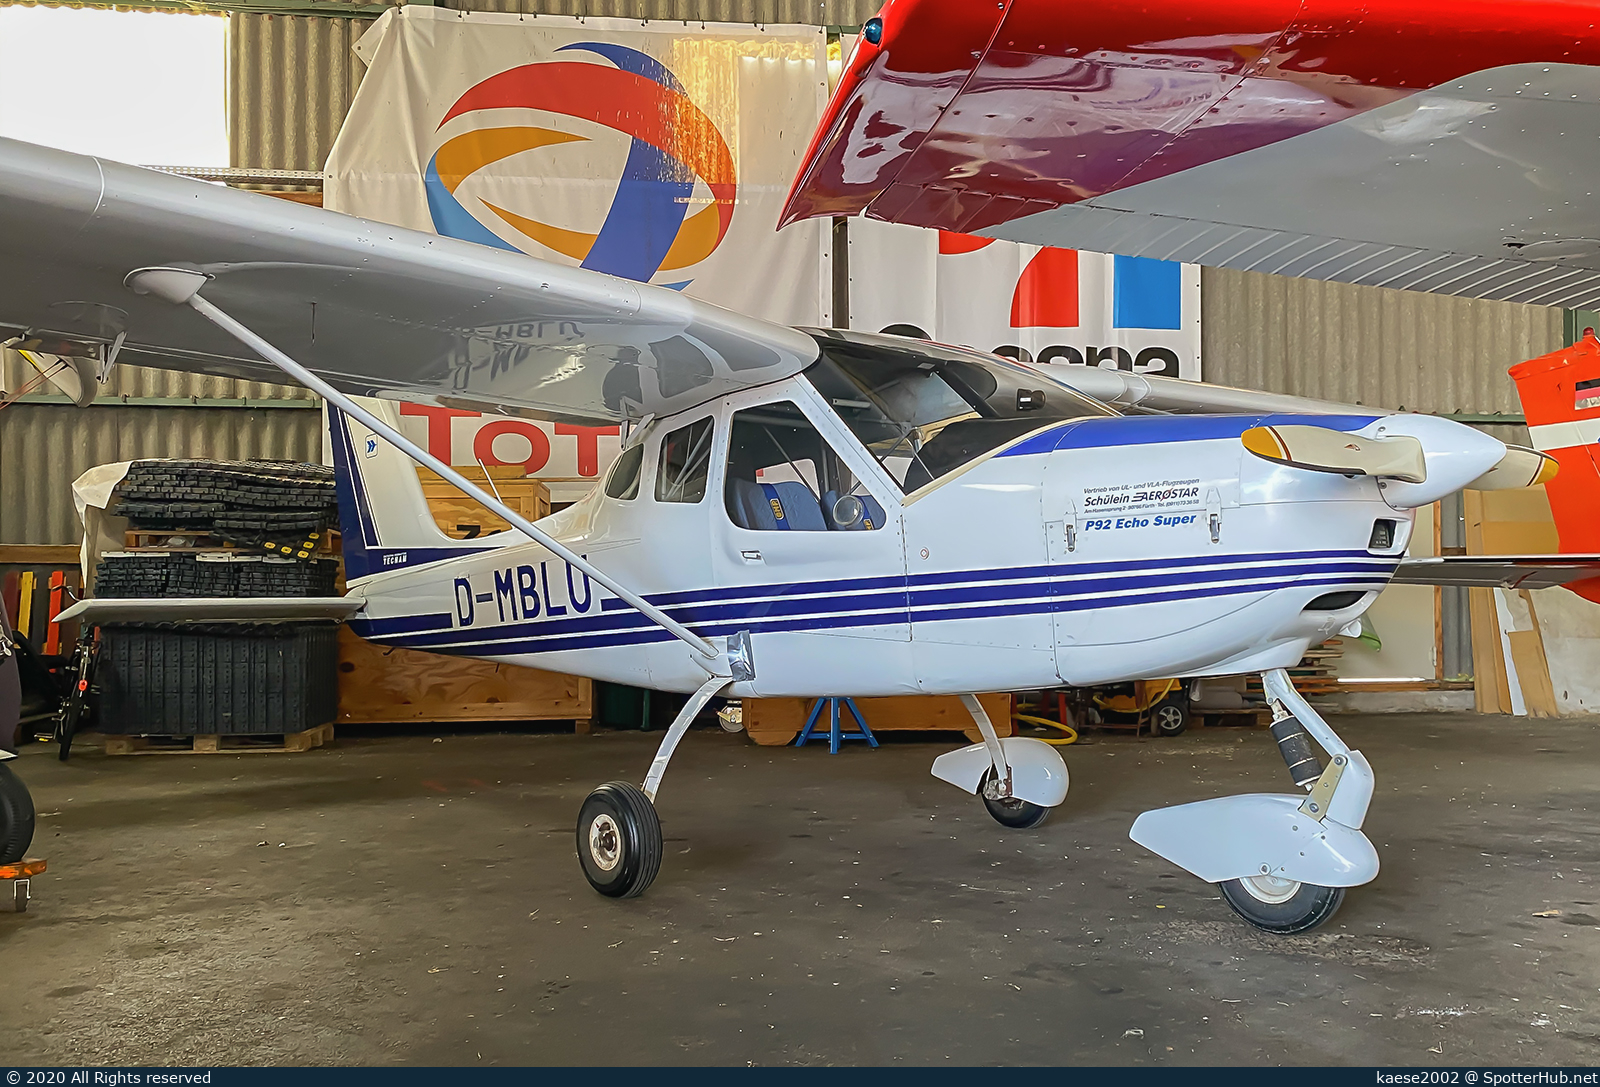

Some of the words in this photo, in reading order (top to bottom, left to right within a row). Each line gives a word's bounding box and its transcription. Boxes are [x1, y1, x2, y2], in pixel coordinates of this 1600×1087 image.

[400, 402, 620, 477] TOT
[1147, 479, 1200, 488] VLA-Flugzeugen
[1084, 493, 1130, 507] Schülein
[1085, 519, 1112, 531] P92
[1115, 517, 1149, 529] Echo
[1153, 515, 1197, 527] Super
[454, 554, 592, 626] D-MBLU
